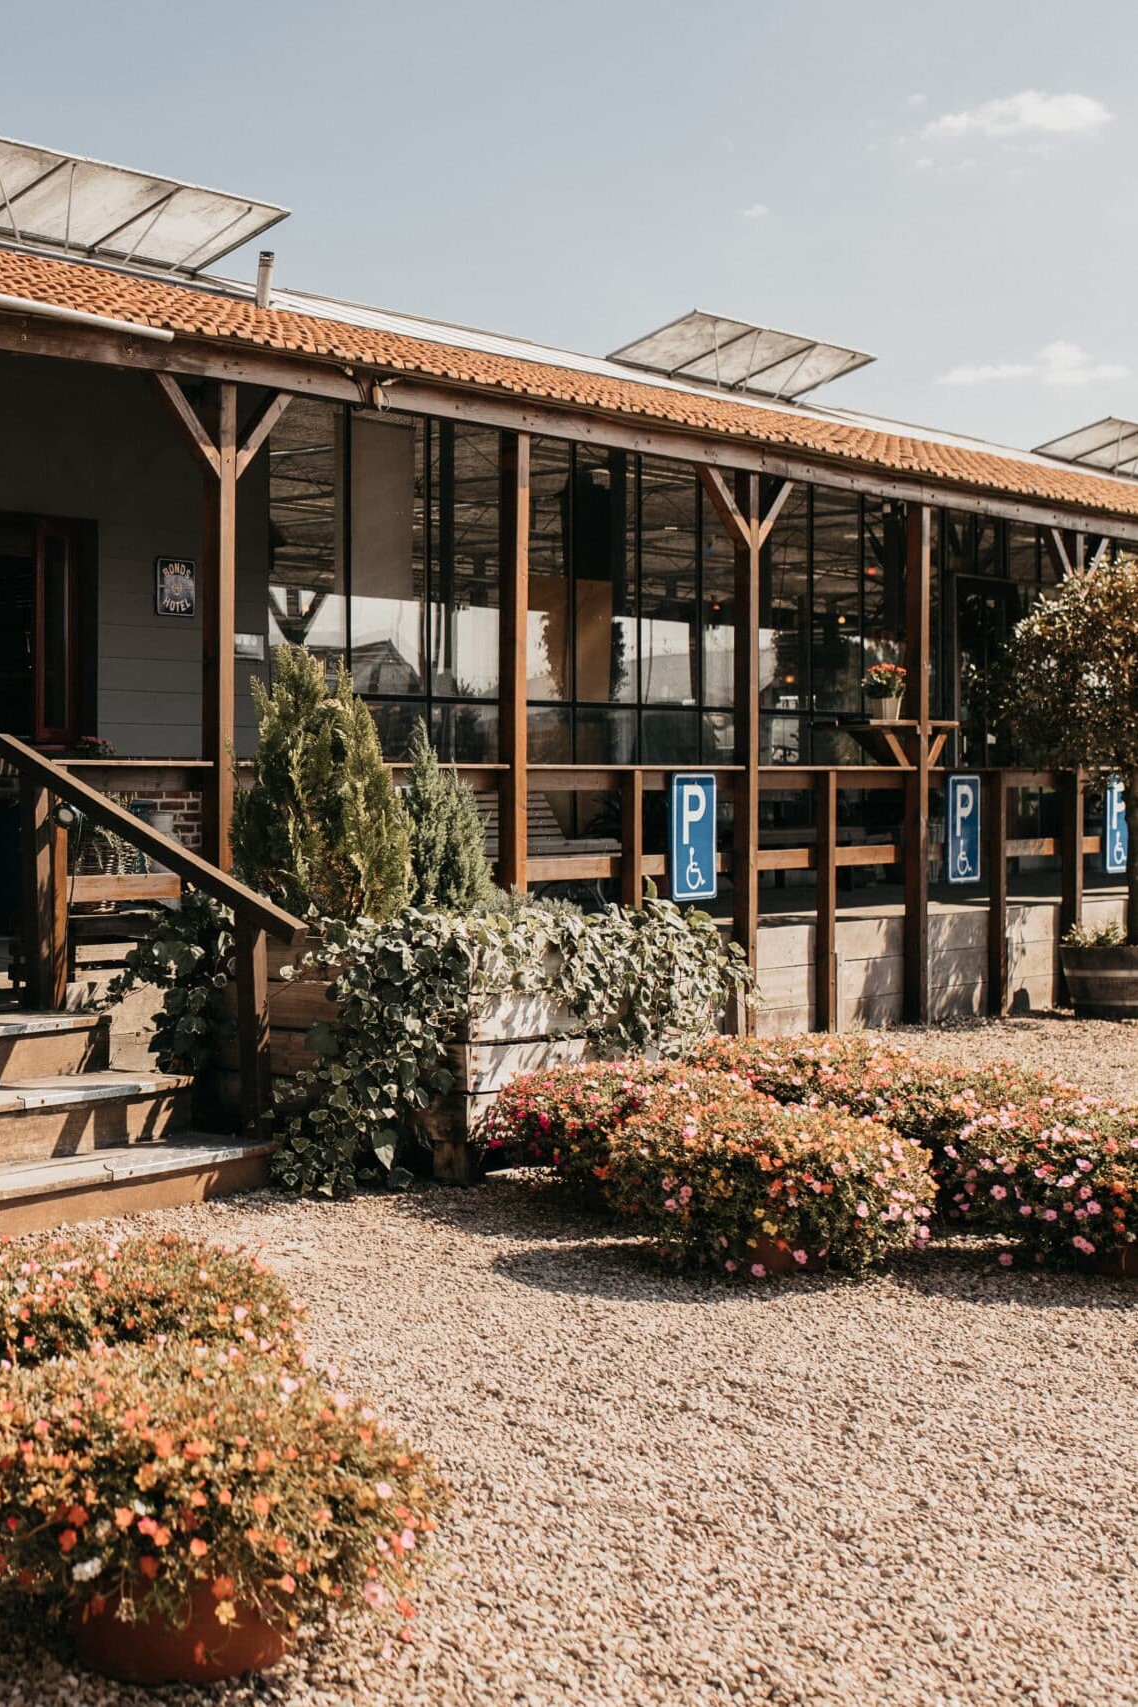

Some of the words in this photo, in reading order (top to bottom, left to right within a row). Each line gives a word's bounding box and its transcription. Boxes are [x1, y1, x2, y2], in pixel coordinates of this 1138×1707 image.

[162, 562, 192, 580] BONDS
[162, 595, 192, 613] HOTEL
[682, 784, 707, 845] P
[955, 784, 973, 837] P
